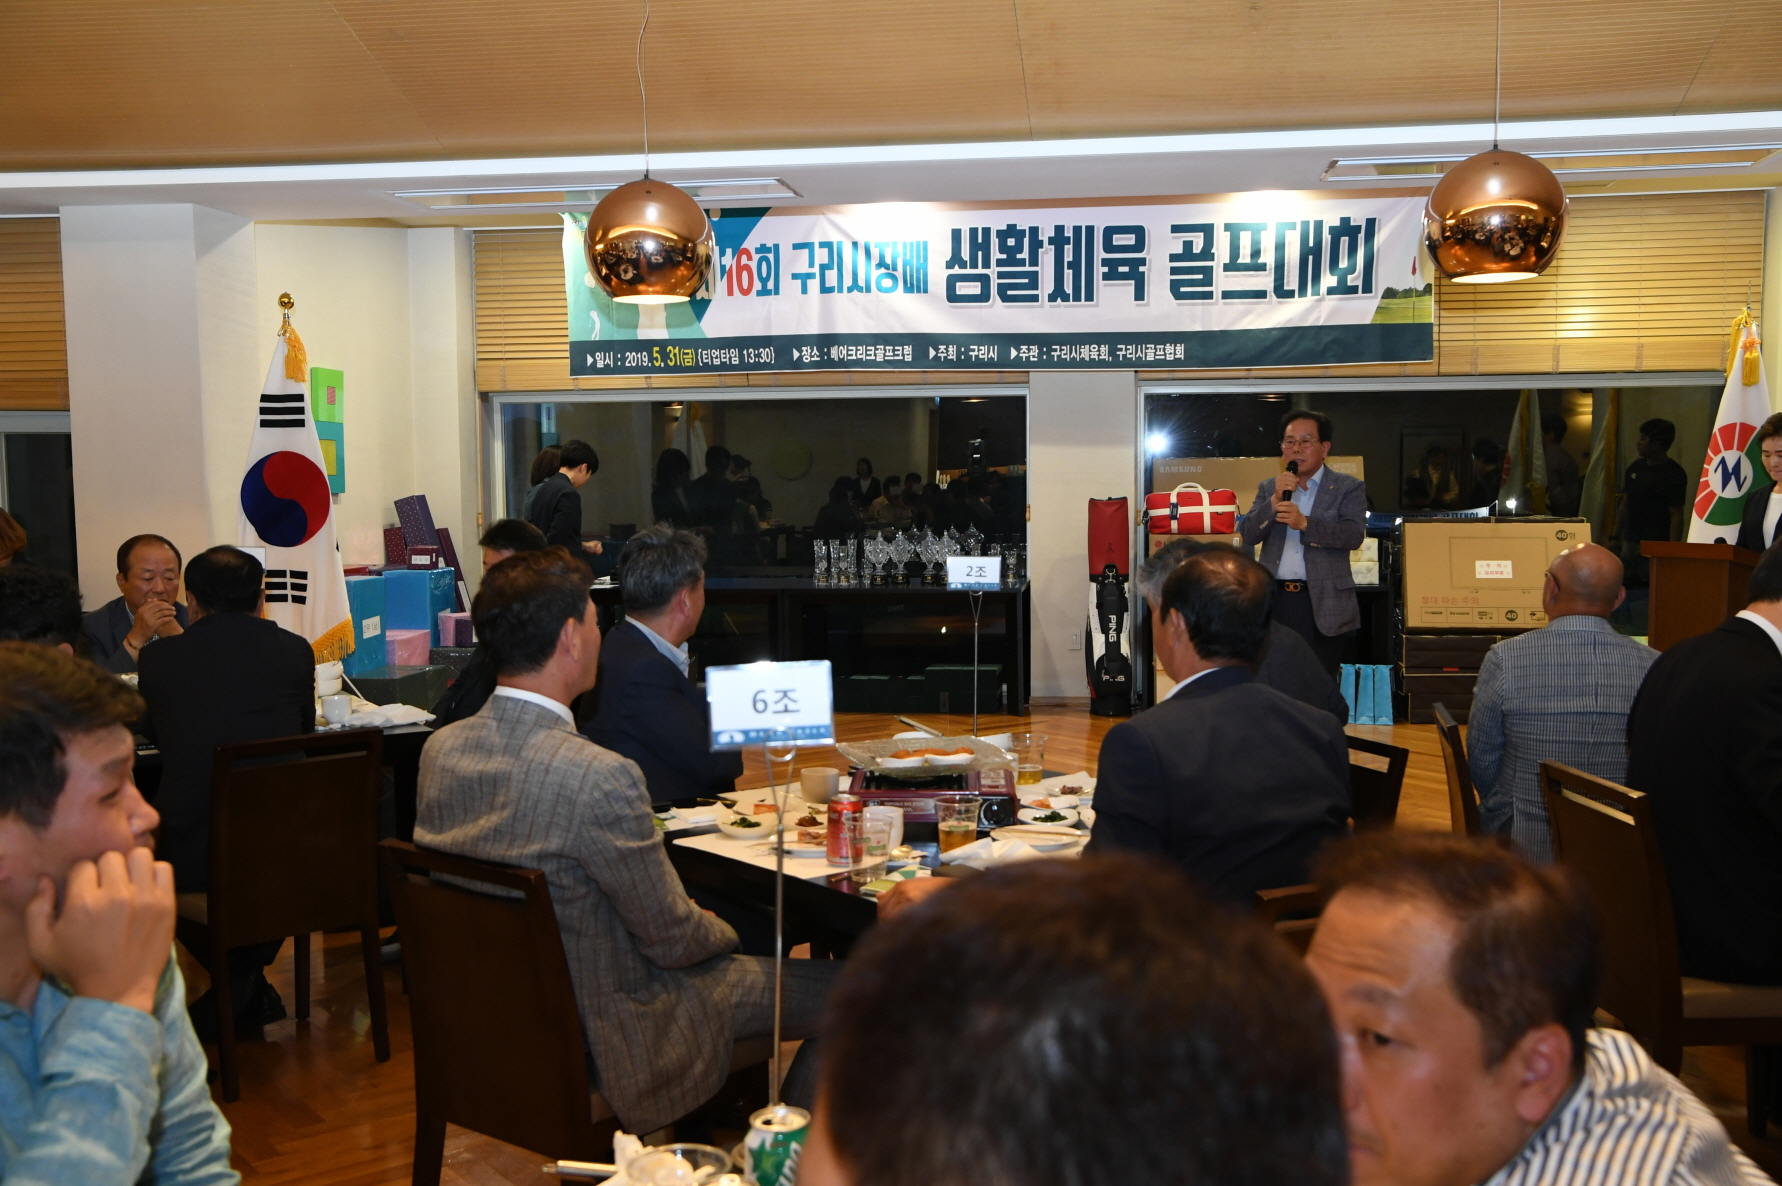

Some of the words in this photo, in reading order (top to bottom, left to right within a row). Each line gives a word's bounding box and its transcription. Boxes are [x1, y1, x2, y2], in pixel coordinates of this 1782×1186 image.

[790, 239, 929, 296] 구리시장배
[944, 223, 1148, 305] 생활체육
[1168, 216, 1378, 302] 골프대회
[595, 352, 613, 368] 일시
[625, 351, 651, 367] 2019.
[666, 345, 696, 367] 31(금)
[801, 346, 821, 363] 장소
[937, 344, 957, 362] 주최
[968, 344, 998, 362] 구리시
[1019, 344, 1039, 361] 주관
[1051, 343, 1113, 362] 구리시체육회,
[1116, 343, 1185, 361] 구리시골프협회
[1159, 465, 1203, 474] SAMSUNG
[965, 565, 987, 578] 2조
[1108, 614, 1117, 642] PING
[752, 689, 800, 714] 6조
